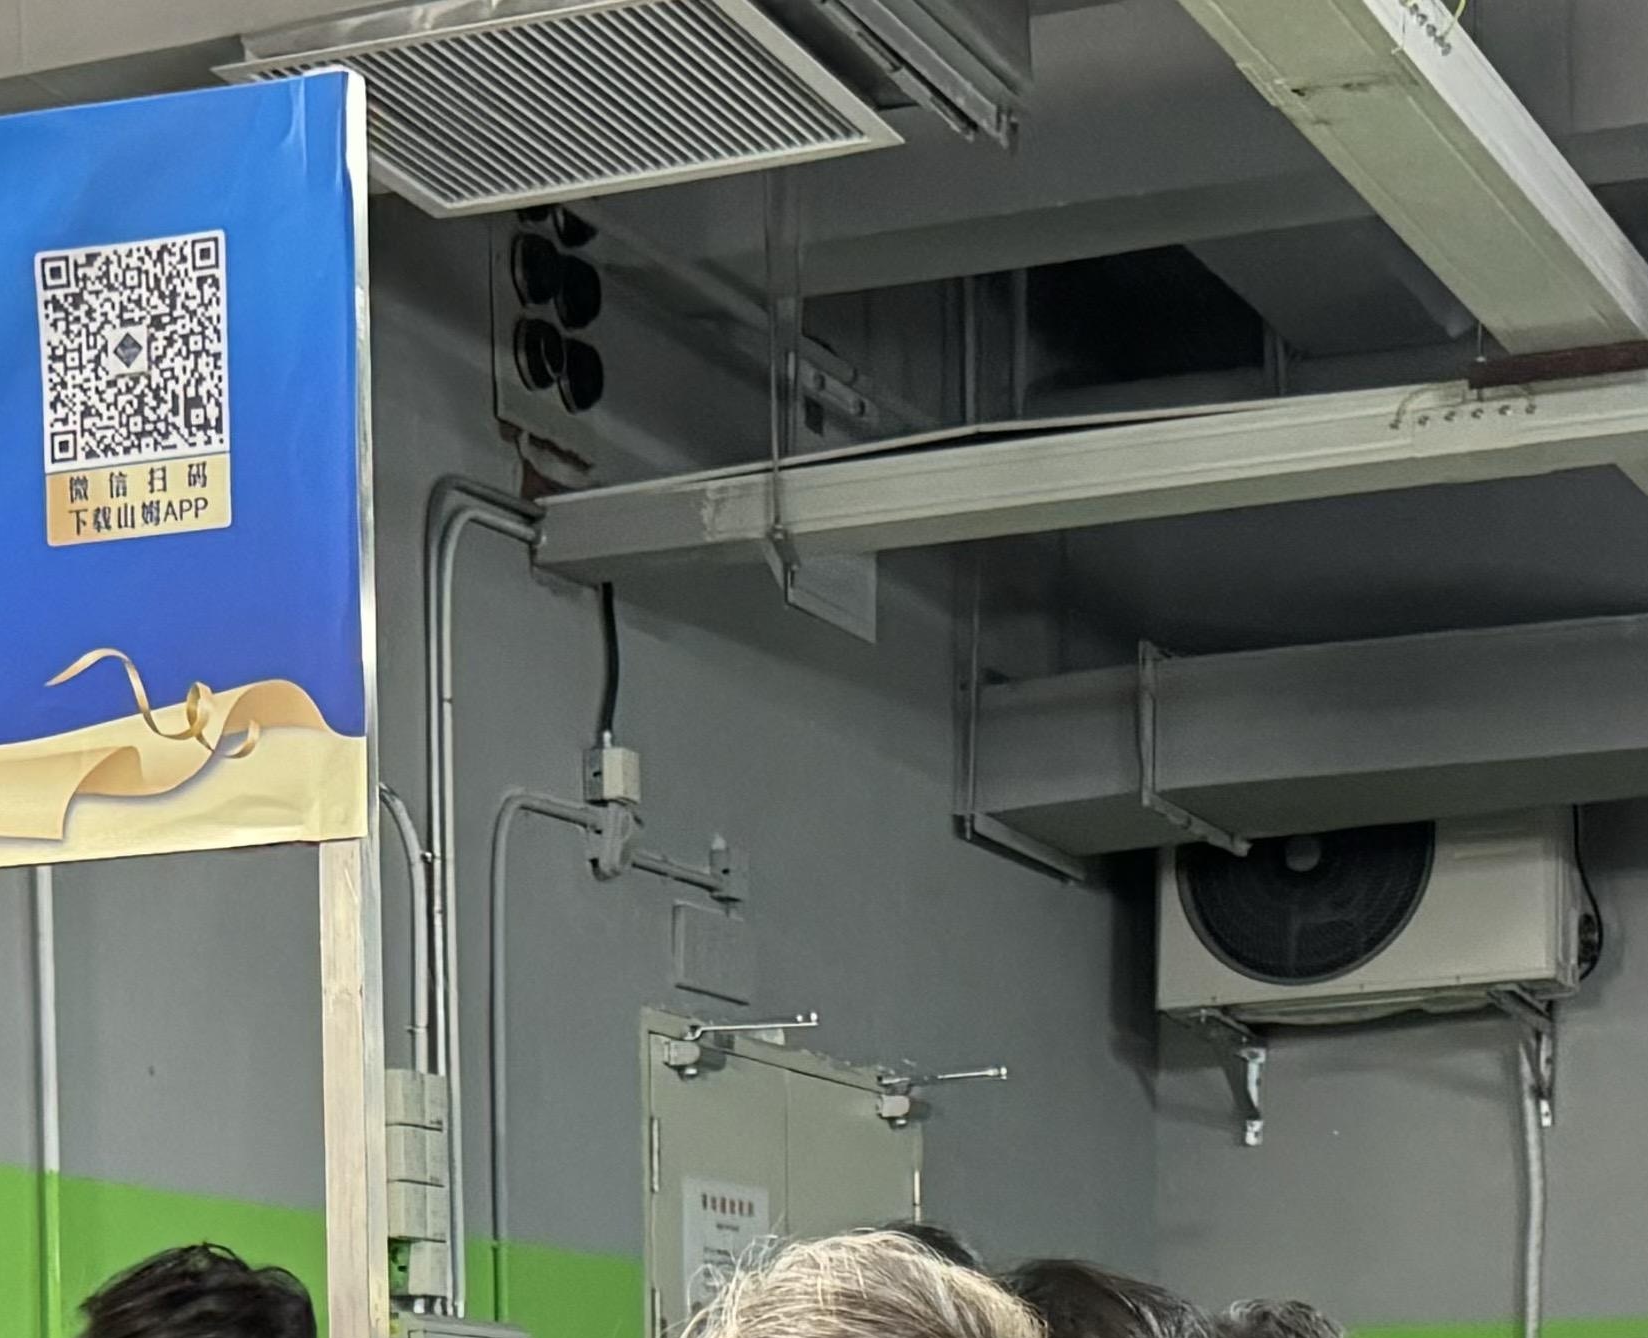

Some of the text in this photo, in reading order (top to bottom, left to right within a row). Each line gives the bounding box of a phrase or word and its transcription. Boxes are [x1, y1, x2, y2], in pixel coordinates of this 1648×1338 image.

[68, 461, 208, 502] 微信扫码
[68, 496, 209, 537] 下载山姆APP
